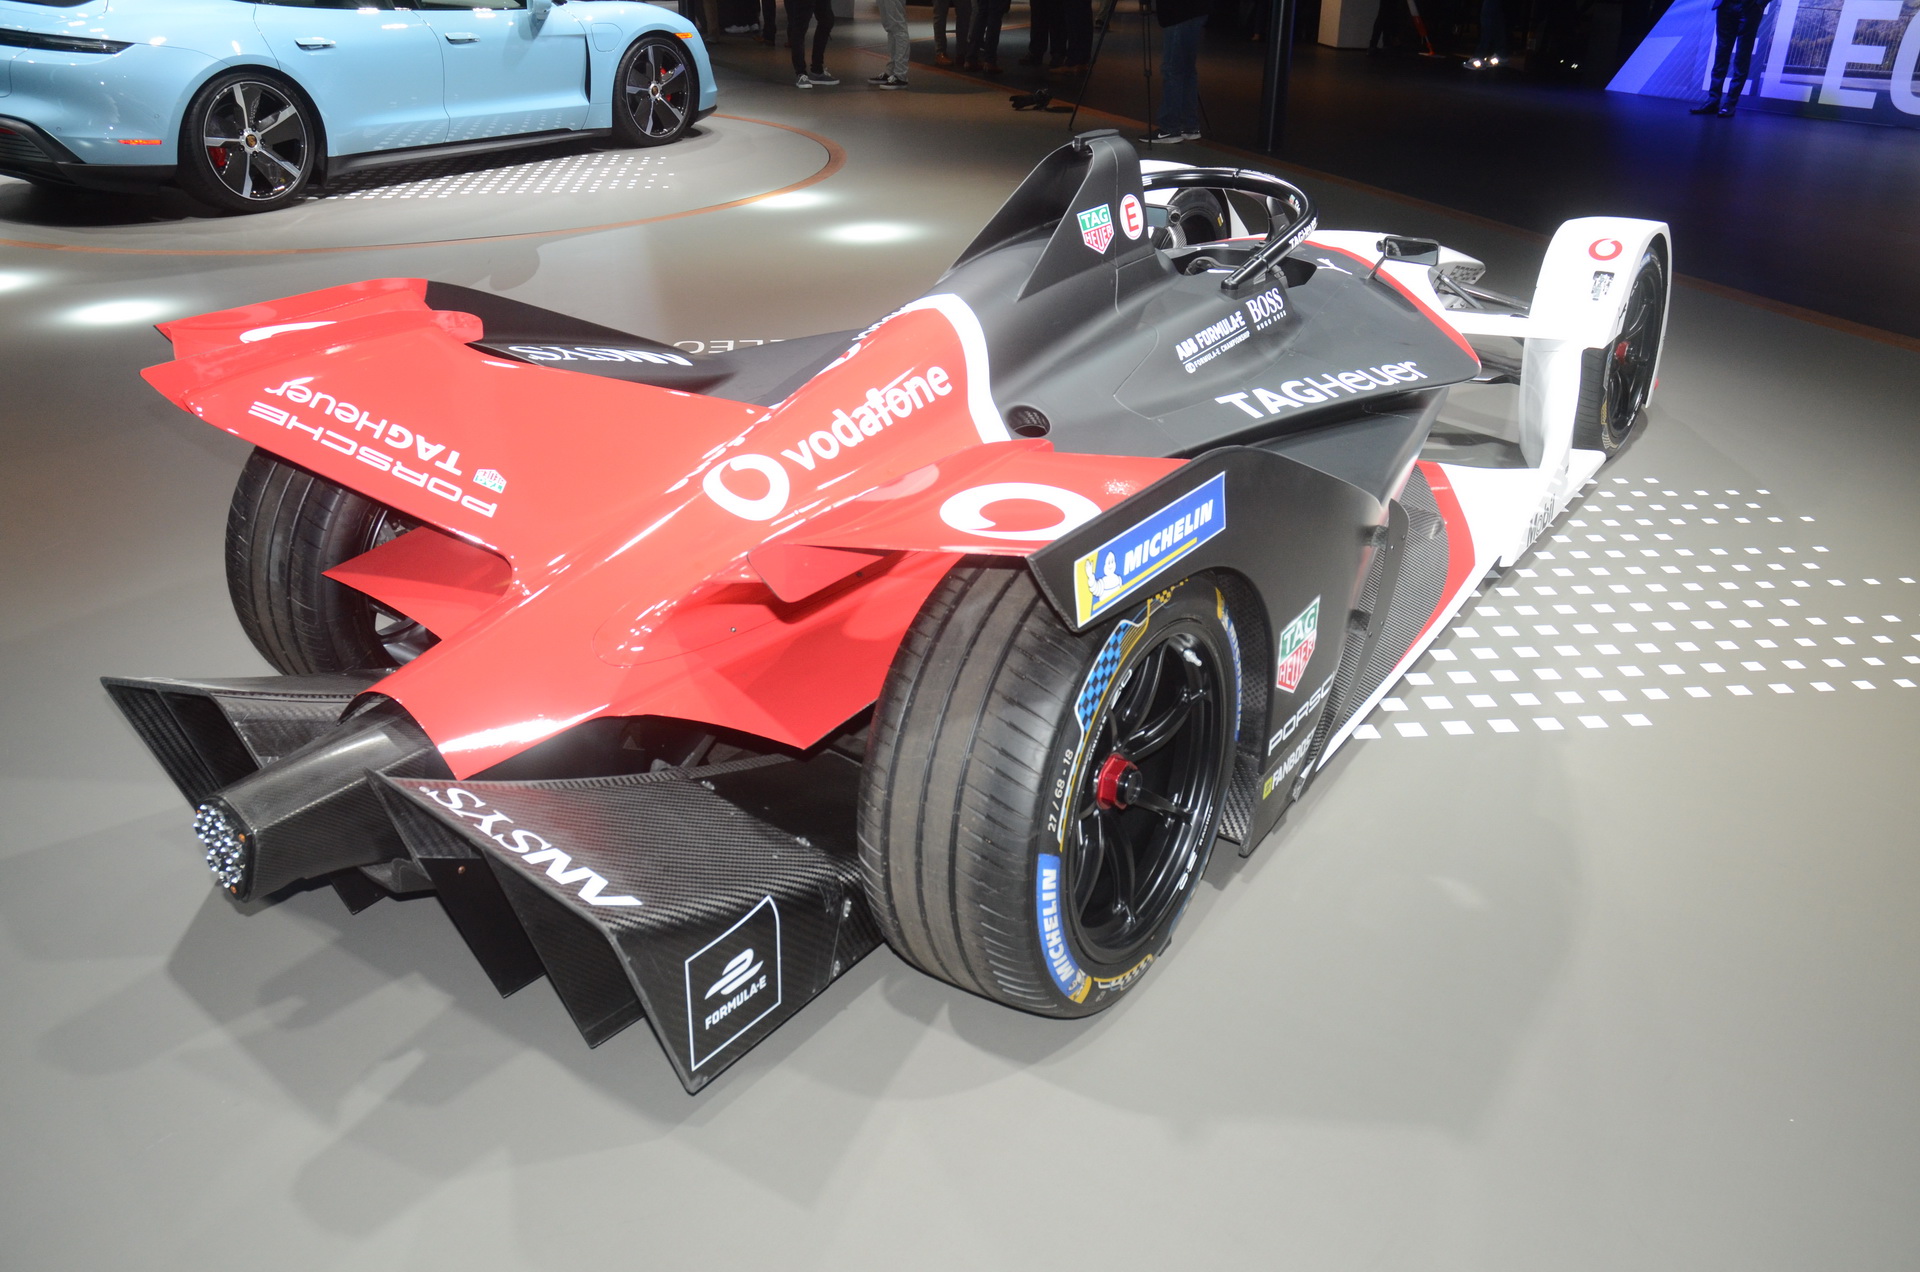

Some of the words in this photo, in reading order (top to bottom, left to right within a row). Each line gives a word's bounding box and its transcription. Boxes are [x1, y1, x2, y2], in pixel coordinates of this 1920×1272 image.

[1080, 206, 1110, 229] TAG
[1084, 225, 1113, 250] HEUER
[1245, 287, 1284, 323] BOSS
[508, 345, 694, 367] ANSYS
[1175, 337, 1199, 361] ABB
[782, 365, 952, 471] vodafone
[1215, 359, 1429, 420] TAGHeuer
[264, 376, 463, 476] TAGHeuer
[248, 401, 498, 518] PORSCHE
[1124, 499, 1214, 576] MICHELIN
[1279, 638, 1315, 687] HEUER
[1284, 607, 1316, 655] TAG
[1267, 670, 1336, 757] PORSC
[1272, 726, 1317, 791] FANBOOS
[426, 787, 643, 906] ANSYS
[1042, 868, 1075, 982] MICHELIN
